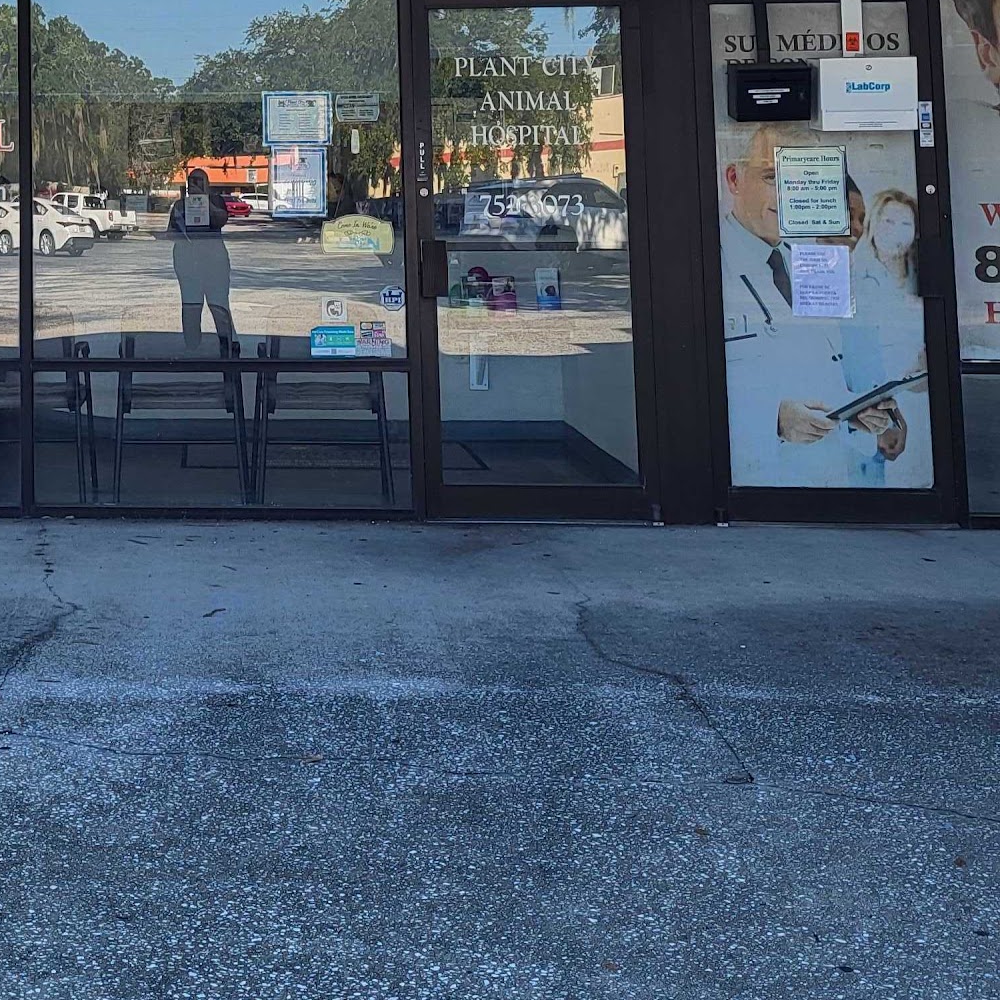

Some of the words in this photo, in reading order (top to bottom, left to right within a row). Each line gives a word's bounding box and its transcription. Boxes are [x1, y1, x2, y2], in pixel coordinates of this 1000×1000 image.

[775, 29, 900, 52] MÉDIOS
[454, 56, 533, 77] PLANT
[542, 56, 598, 77] CITY
[851, 81, 891, 92] LabCorp
[479, 90, 578, 111] ANIMAL
[471, 125, 586, 146] HOSPITAL
